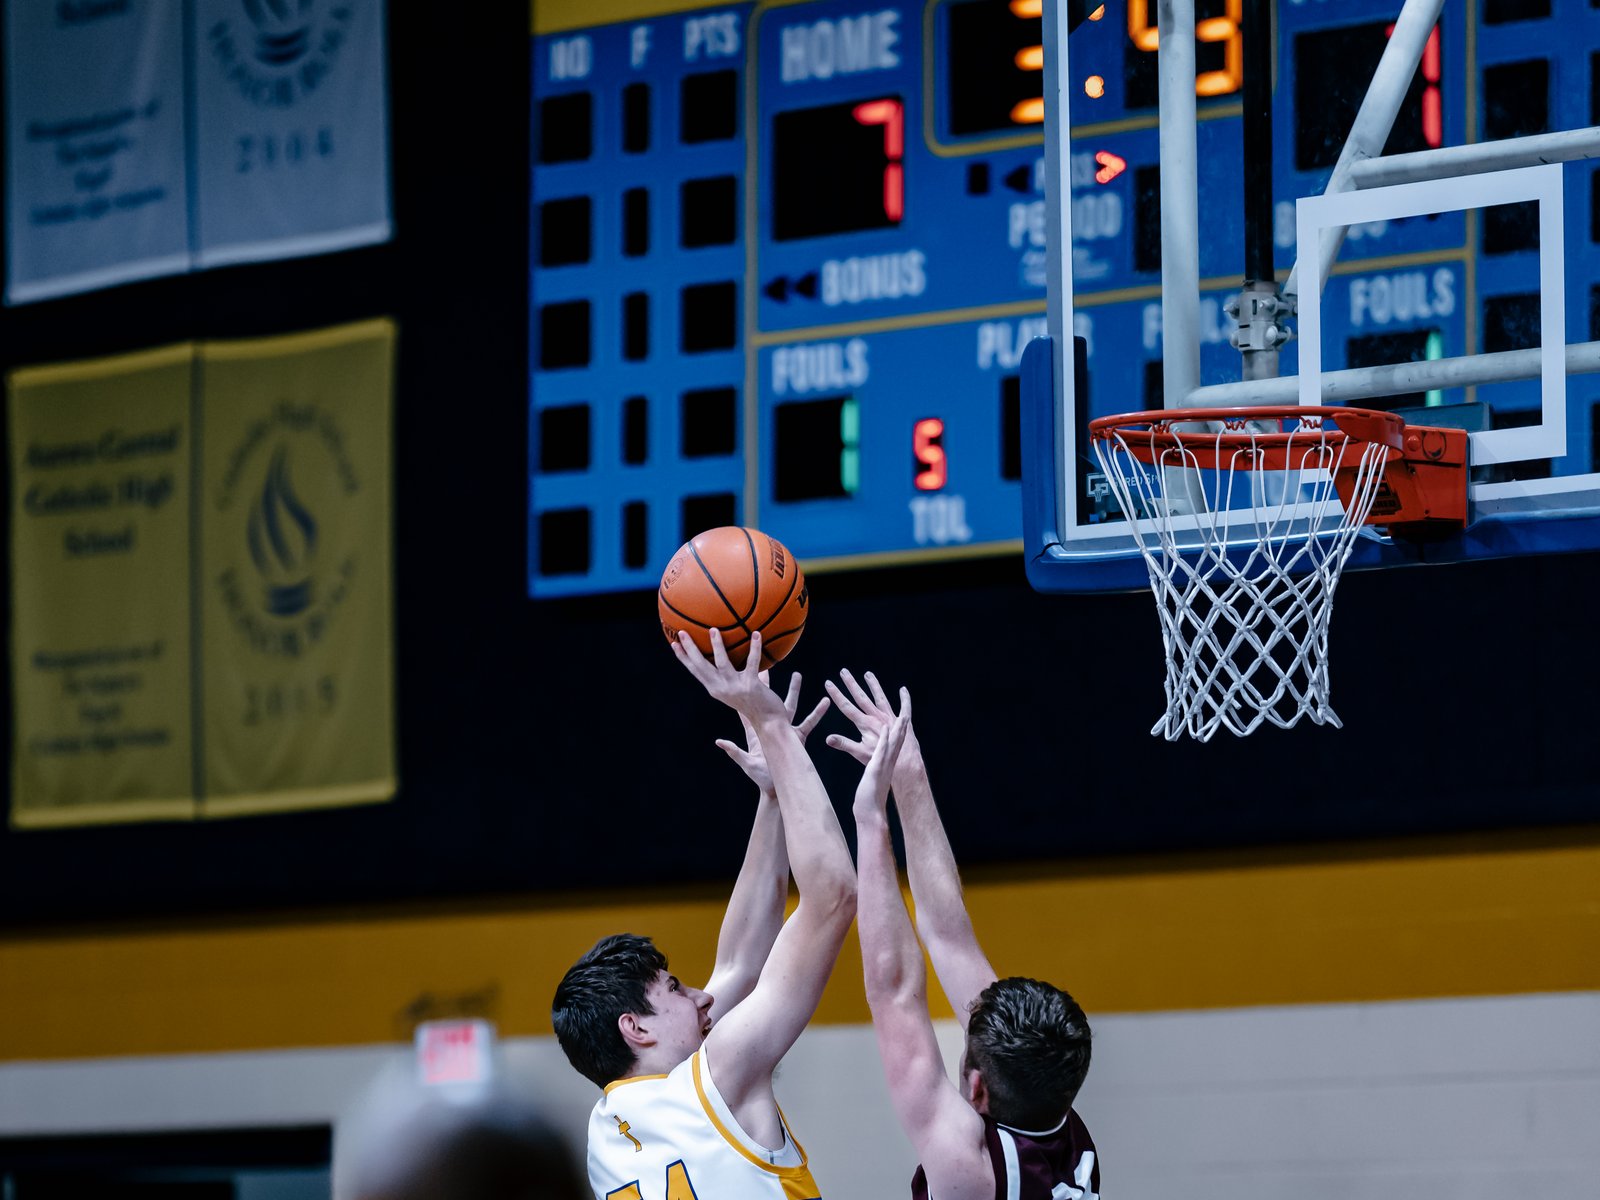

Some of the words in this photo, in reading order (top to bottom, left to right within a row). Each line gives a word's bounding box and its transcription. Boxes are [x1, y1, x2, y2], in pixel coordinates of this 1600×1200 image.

[630, 25, 648, 67] F
[684, 12, 741, 61] PTS
[780, 9, 900, 83] HOME
[852, 99, 904, 222] 7
[821, 249, 926, 305] BONUS
[1350, 268, 1455, 327] FOULS
[772, 339, 868, 394] FOULS
[913, 417, 948, 490] 5
[909, 494, 973, 545] TOL
